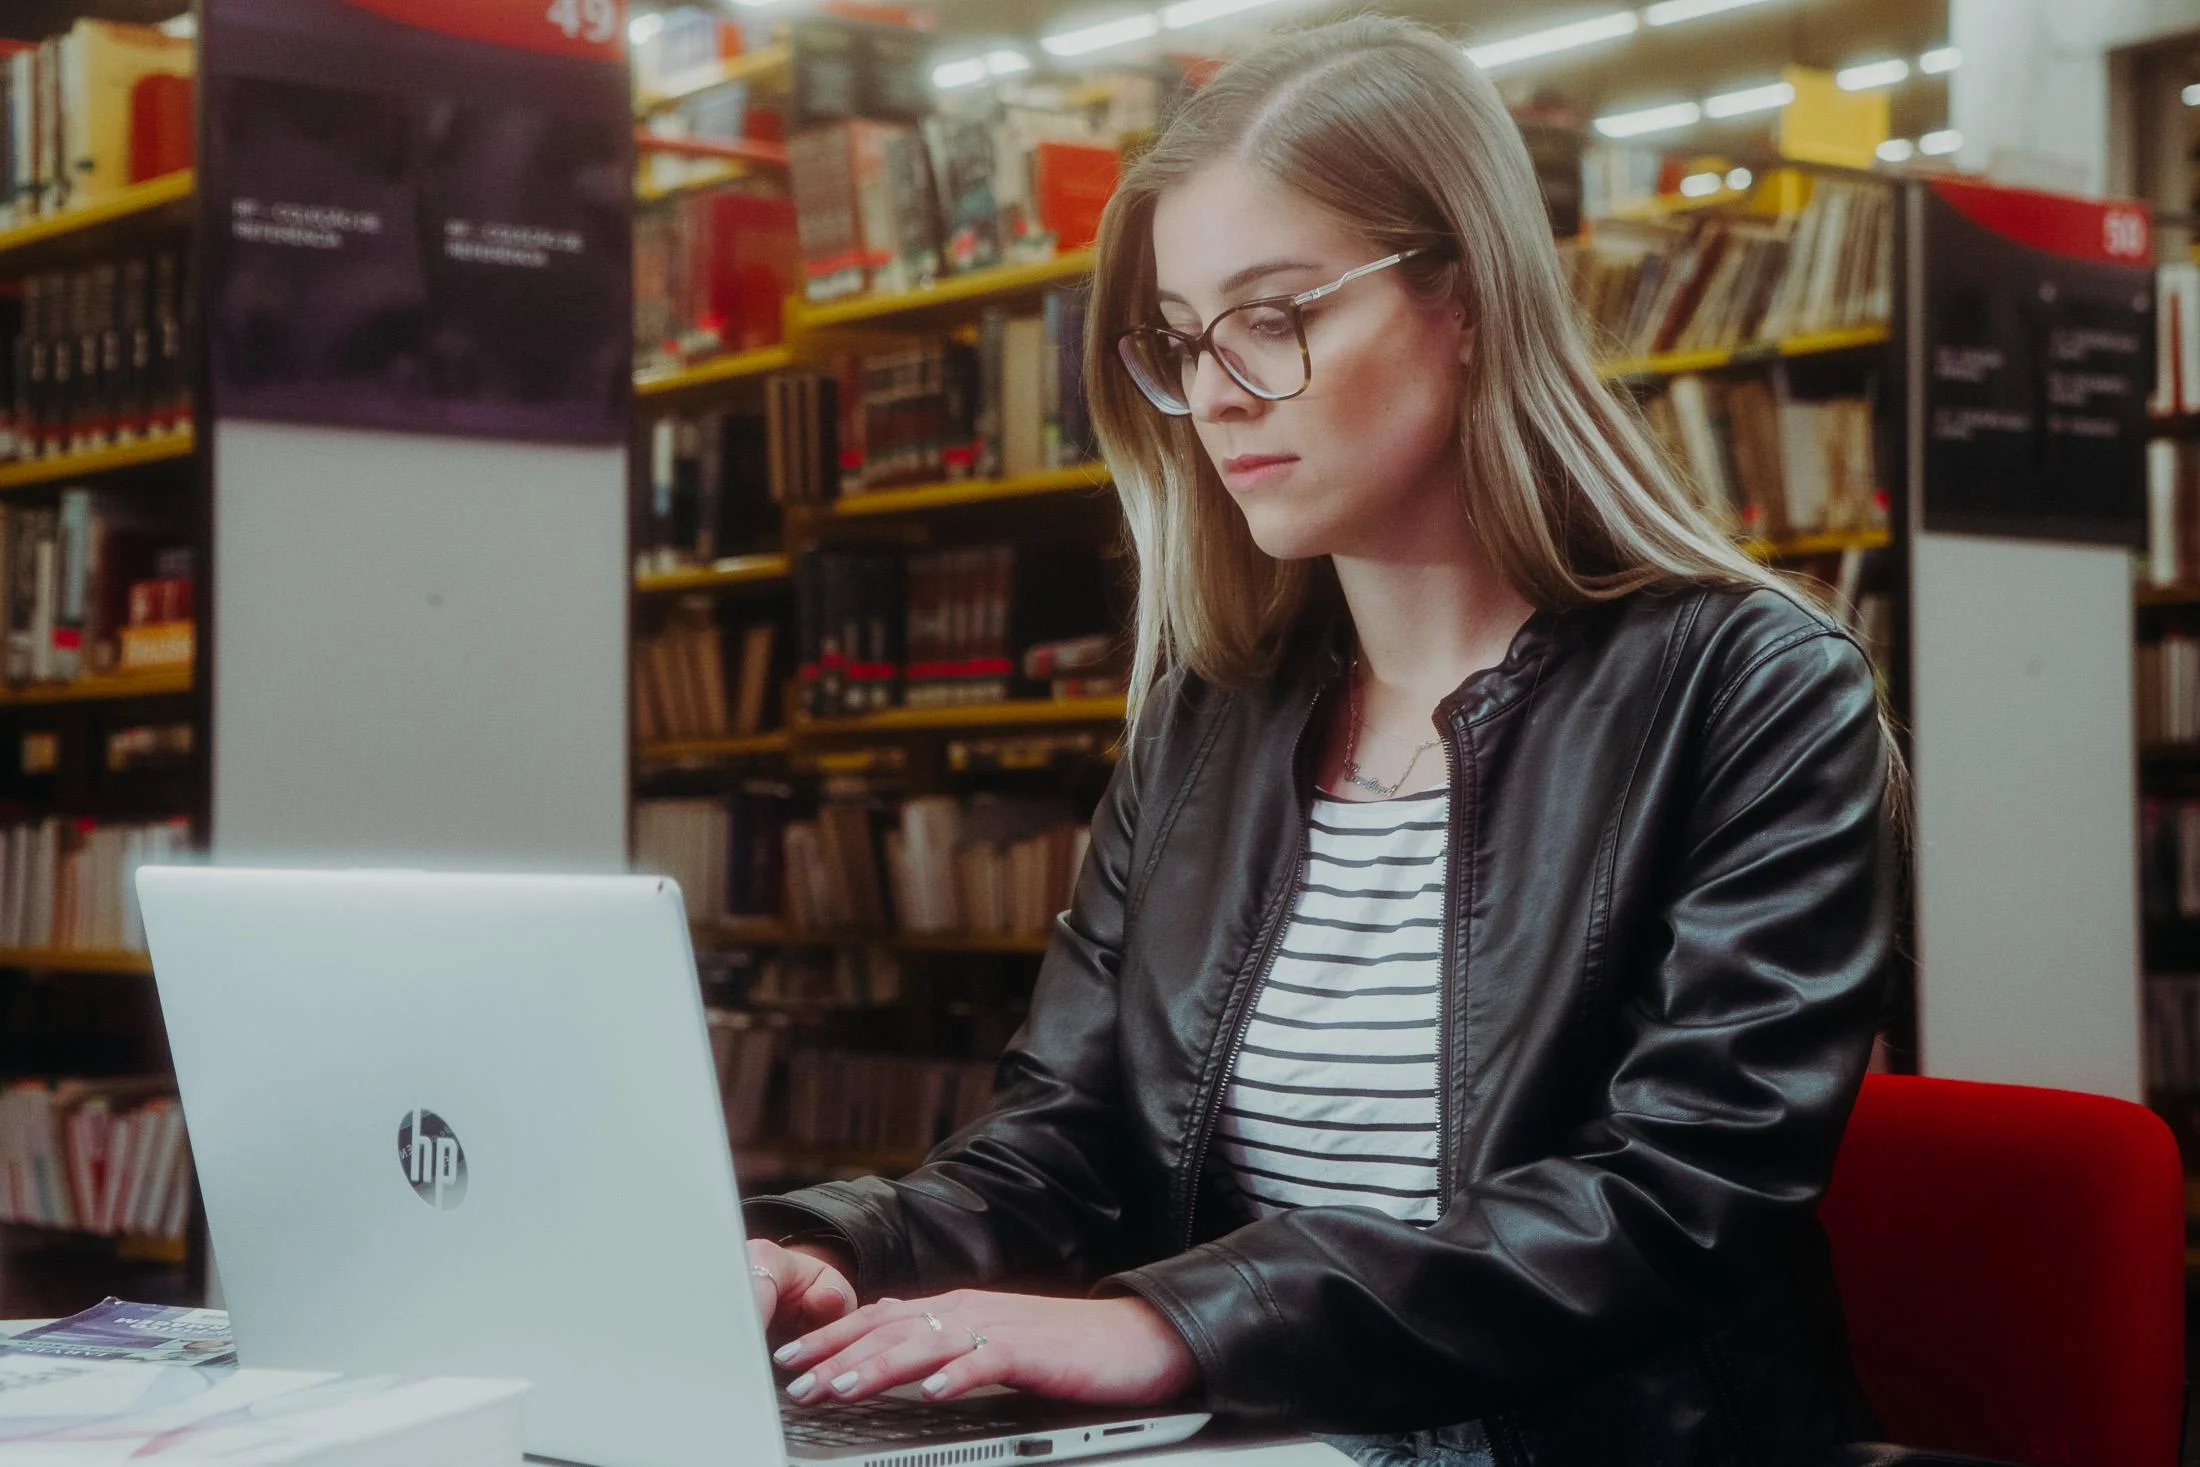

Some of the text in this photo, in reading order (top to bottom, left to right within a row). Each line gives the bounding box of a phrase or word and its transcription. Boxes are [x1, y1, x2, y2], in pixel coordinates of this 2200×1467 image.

[547, 0, 613, 42] 49
[2103, 211, 2146, 255] 50
[410, 1107, 459, 1210] hp
